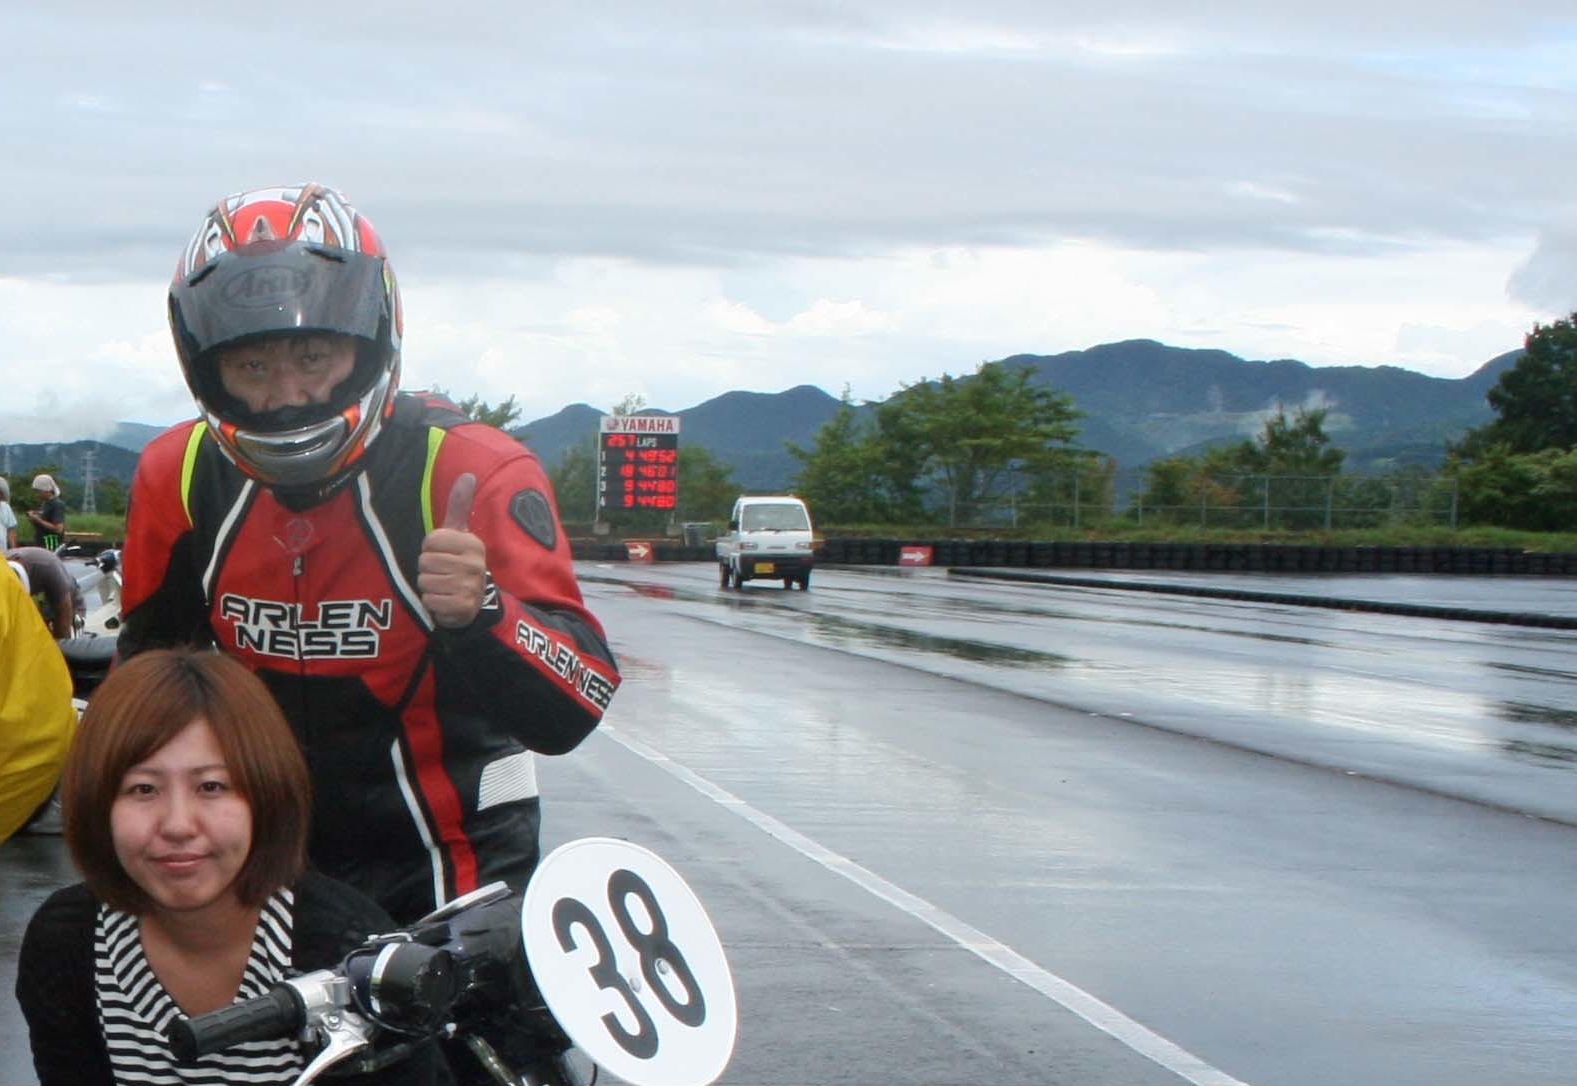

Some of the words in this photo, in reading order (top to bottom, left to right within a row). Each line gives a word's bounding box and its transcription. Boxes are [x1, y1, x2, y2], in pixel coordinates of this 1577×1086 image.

[622, 418, 673, 431] YAMAHA
[637, 437, 657, 448] LAPS
[221, 594, 392, 630] ARLEN
[235, 623, 379, 660] NESS
[515, 620, 579, 684] ARLEN
[550, 868, 707, 1060] 38
